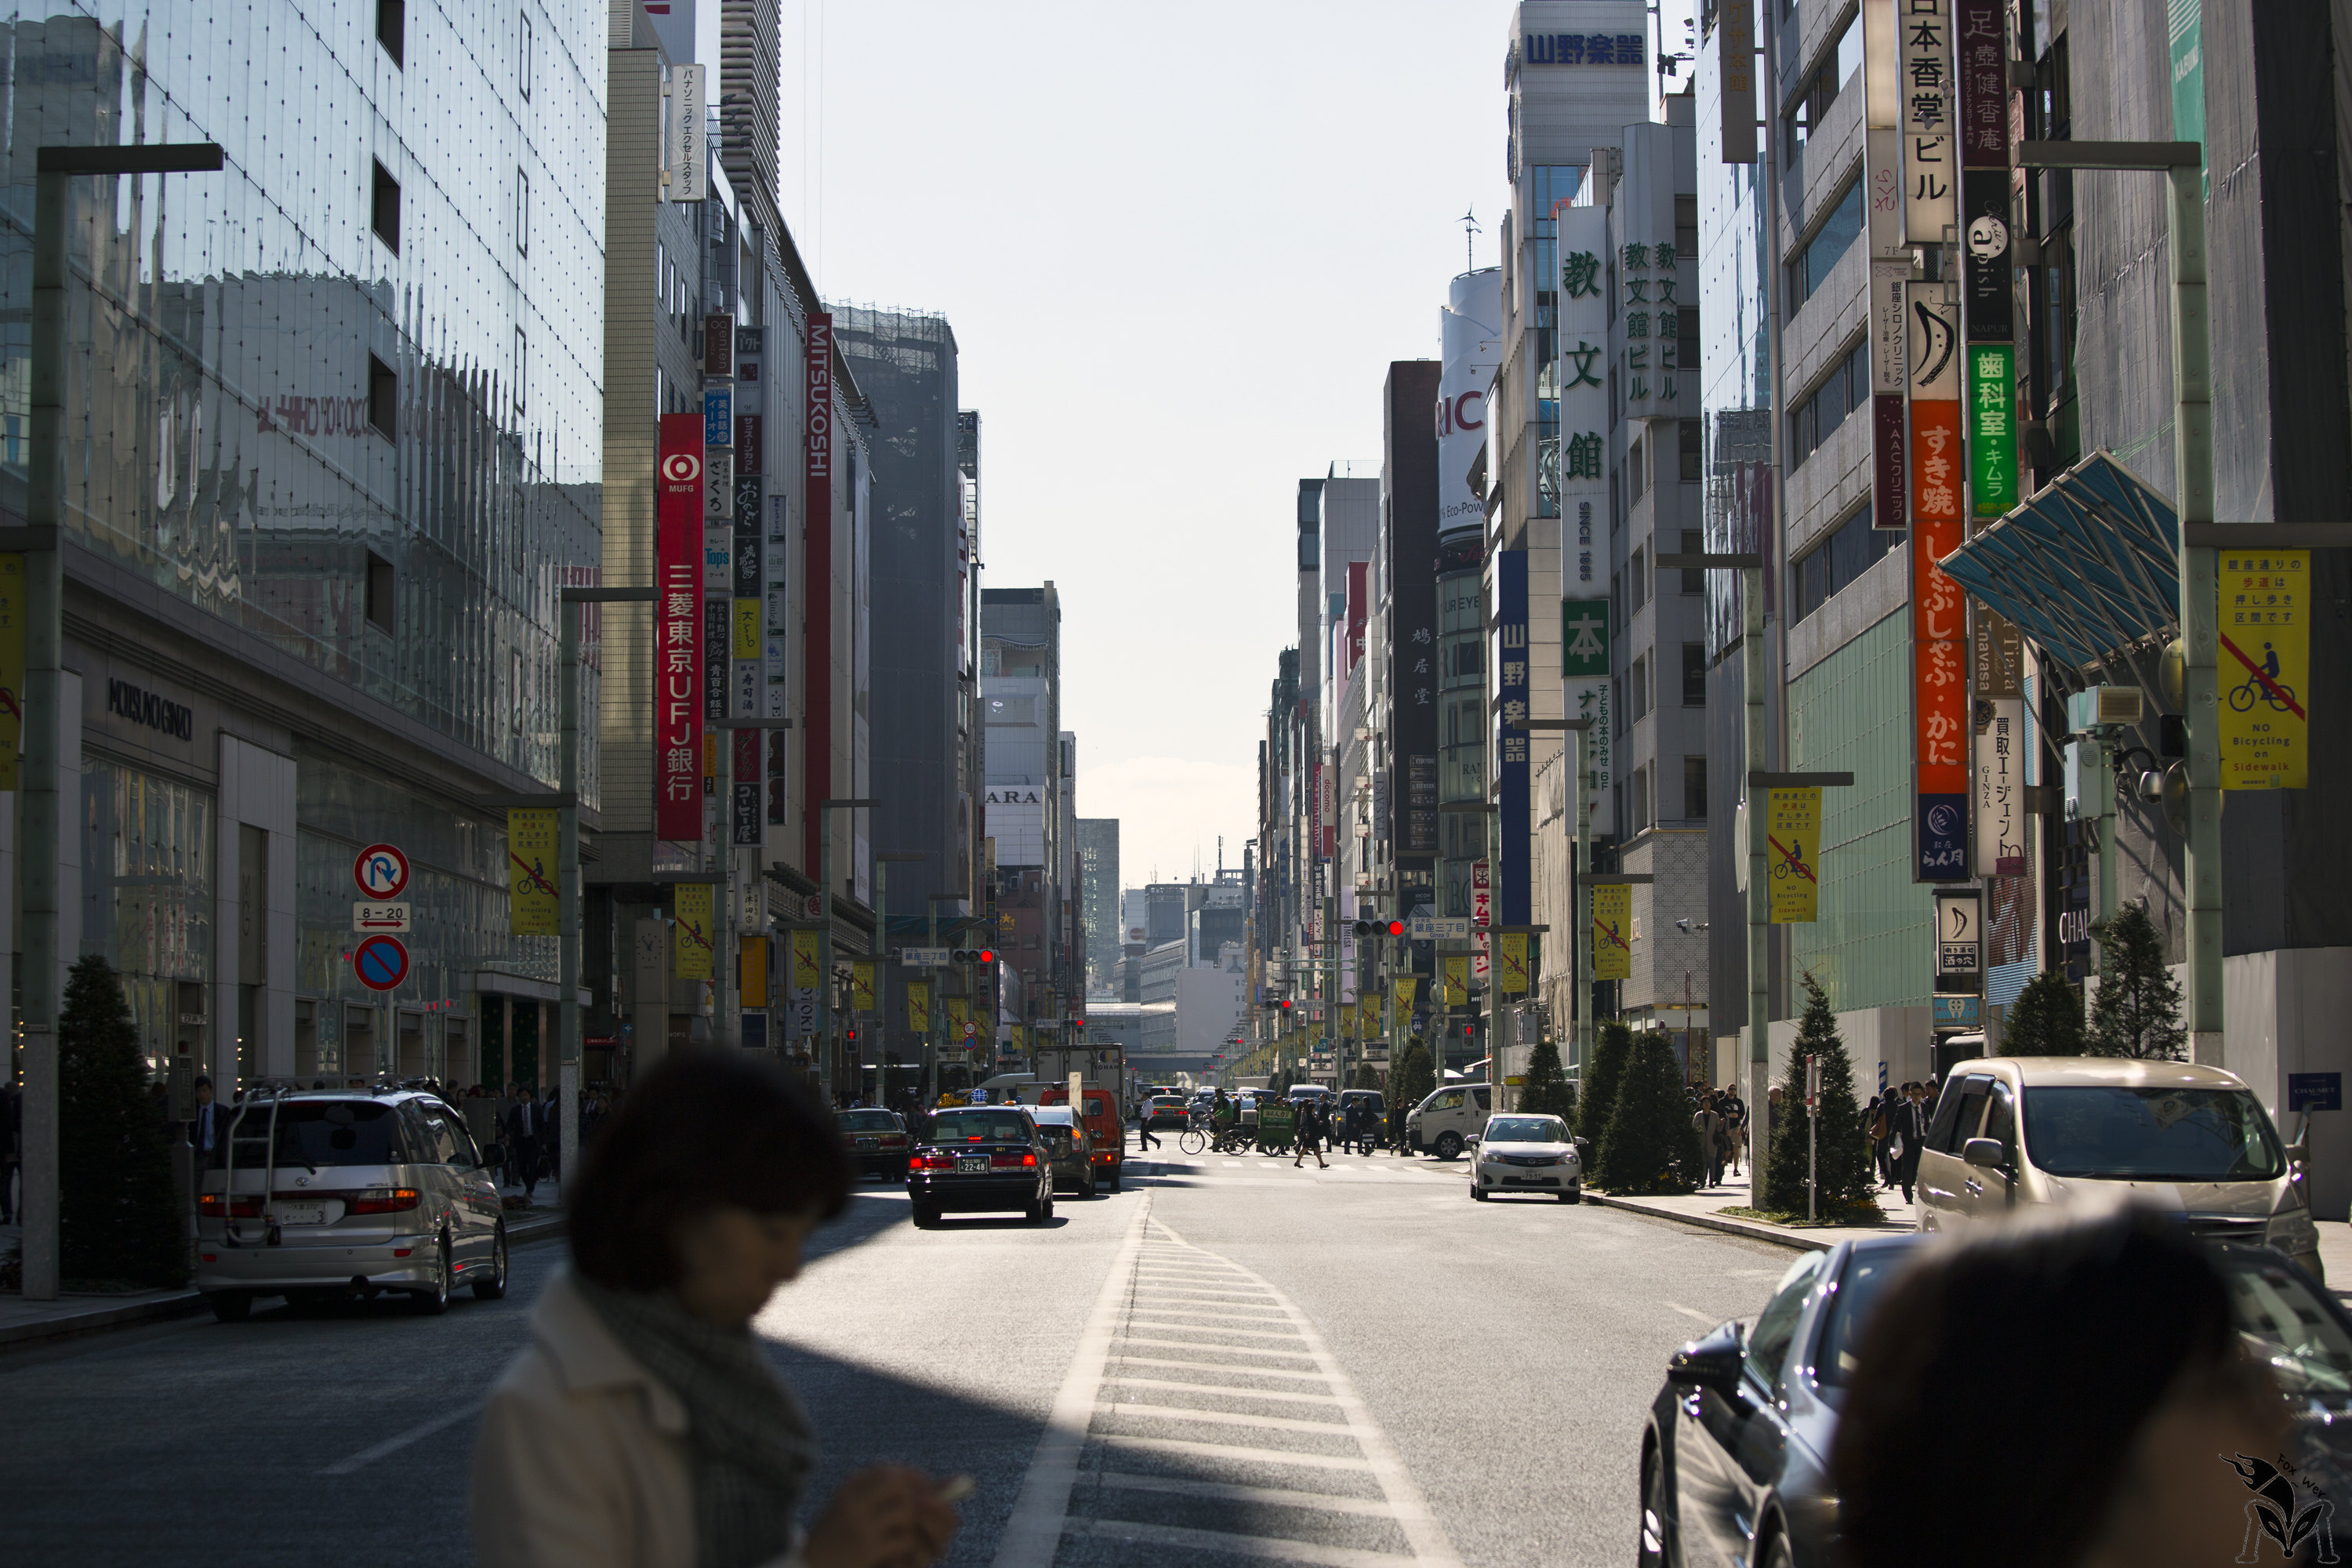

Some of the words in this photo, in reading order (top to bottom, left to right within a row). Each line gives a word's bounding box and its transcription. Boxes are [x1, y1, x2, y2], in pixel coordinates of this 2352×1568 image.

[1527, 34, 1643, 65] 山野楽器
[1969, 230, 1998, 297] apish
[1625, 241, 1649, 401] 教文館ビル
[1656, 241, 1678, 401] 教文館ビル
[1891, 281, 1904, 386] 銀座シロノクリニック
[1563, 251, 1602, 481] 教文館
[708, 400, 717, 442] イーオン
[717, 399, 728, 430] 英会話
[811, 325, 827, 477] MITSUKOSHI
[1976, 352, 2007, 497] 歯科室・キムラ
[1890, 429, 1903, 520] AACクリニック
[1579, 502, 1590, 546] SINCE
[705, 549, 730, 569] Tops
[1579, 550, 1592, 581] 1885
[2228, 559, 2301, 569] 銀座通りの
[1919, 425, 1958, 766] すき焼・しゃぶしゃぶ・かに
[2235, 594, 2293, 604] 押し歩き
[2243, 577, 2285, 587] 歩道は
[1568, 612, 1605, 663] 本
[2235, 612, 2293, 622] 区間です
[667, 565, 694, 801] 三菱東京UFJ銀行
[1411, 628, 1431, 705] 鳩居堂
[1504, 624, 1526, 762] 山野楽器
[1599, 684, 1608, 767] 子どもの本のみせ
[2233, 737, 2290, 746] Bicycling
[2252, 724, 2270, 732] NO
[1600, 771, 1609, 791] 6F
[1982, 766, 1991, 808] GINZA
[1996, 717, 2012, 857] 買取エージェント
[2234, 762, 2289, 771] Sidewalk
[1375, 780, 1385, 834] TASAKI
[1923, 848, 1964, 867] らん月
[1414, 923, 1465, 932] 銀座三丁目
[1945, 956, 1974, 966] 酒の穴
